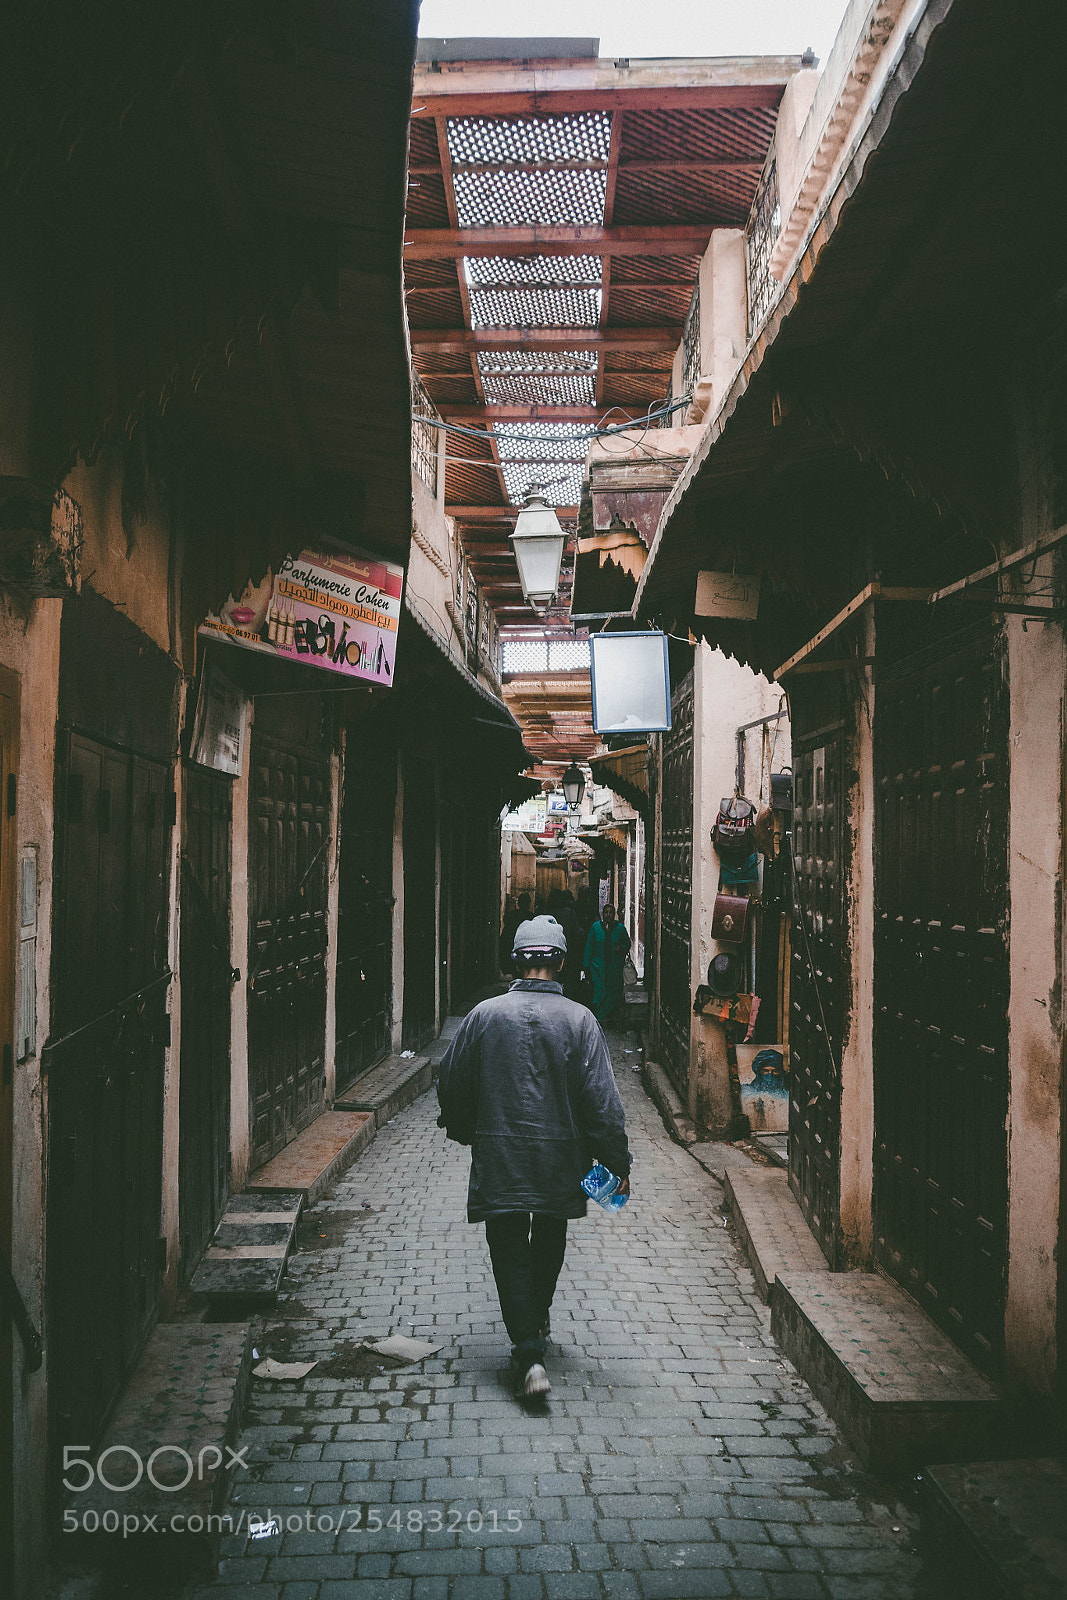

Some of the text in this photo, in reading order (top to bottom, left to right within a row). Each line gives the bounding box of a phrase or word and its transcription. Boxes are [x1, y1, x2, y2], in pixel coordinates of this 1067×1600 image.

[278, 557, 390, 610] Parfumerie Cohen
[278, 578, 391, 629] بيع العطور ومواد التجميل
[244, 631, 251, 639] 97
